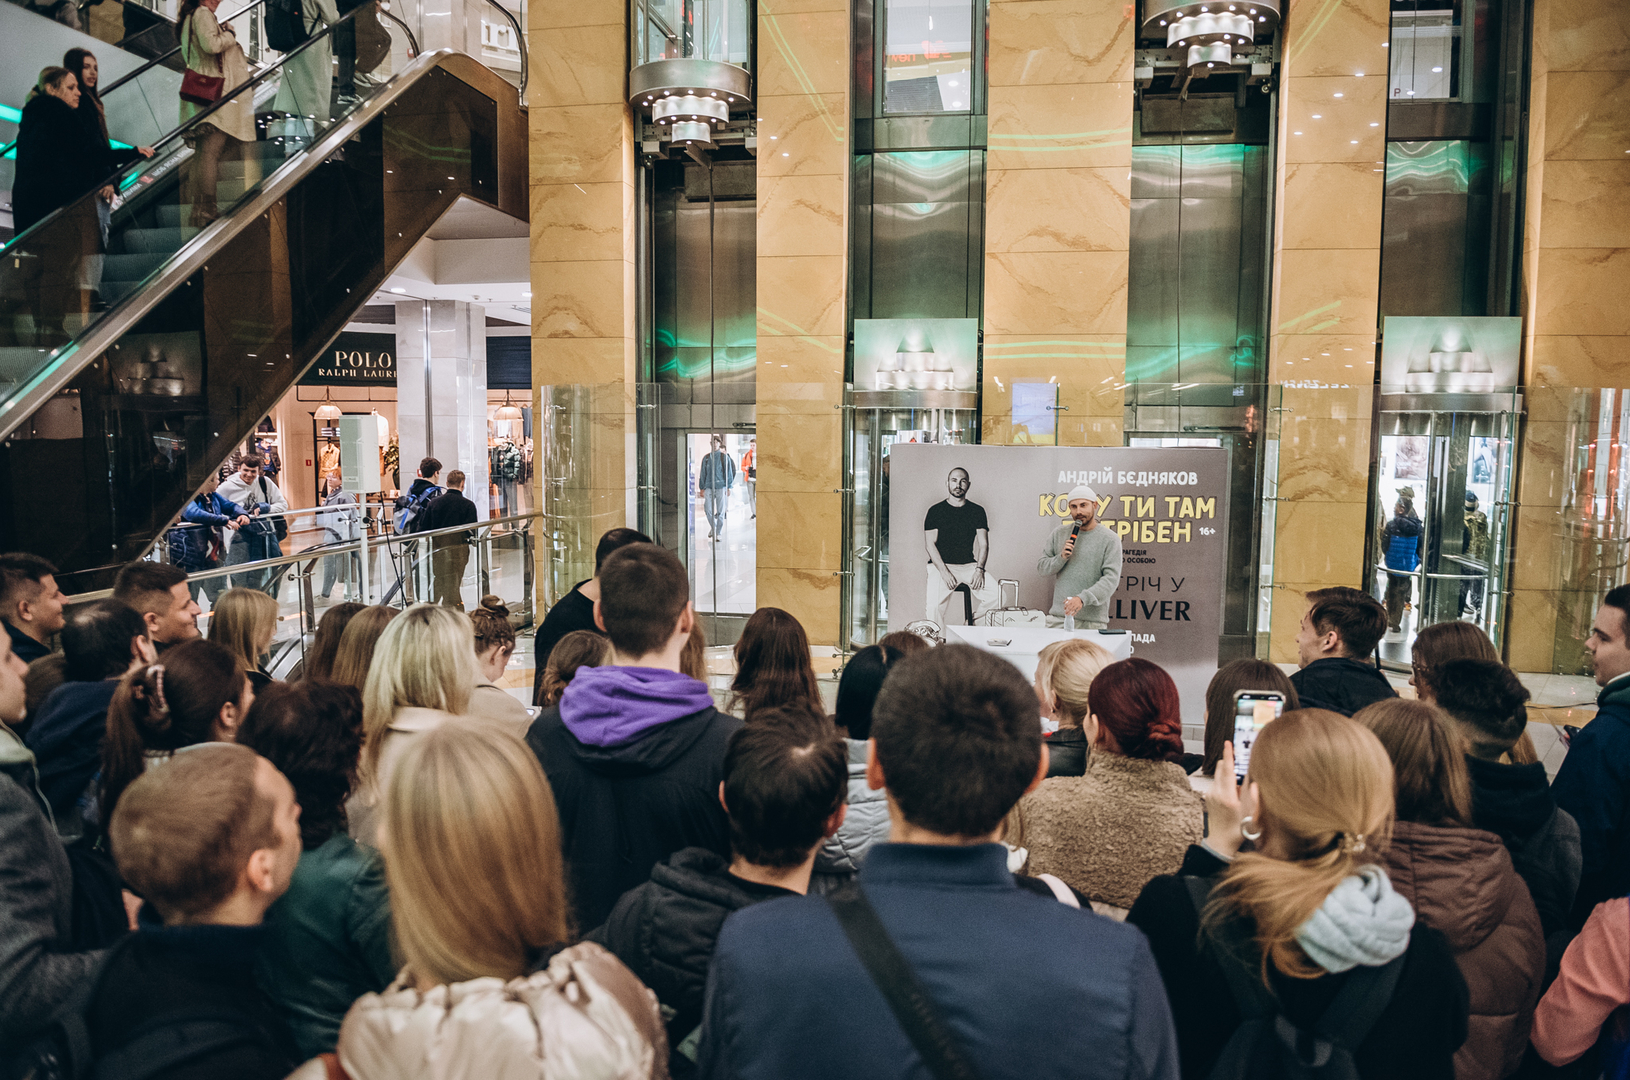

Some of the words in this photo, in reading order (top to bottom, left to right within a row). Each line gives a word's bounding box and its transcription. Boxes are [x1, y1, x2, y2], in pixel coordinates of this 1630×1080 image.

[335, 351, 392, 368] POLO
[318, 368, 357, 377] RALPH
[1058, 466, 1113, 486] АНДРІЙ
[1117, 471, 1198, 487] БЄДНЯКОВ
[1038, 493, 1113, 518] КОУ
[1119, 495, 1155, 519] ТИ
[1164, 495, 1217, 520] ТАМ
[1199, 526, 1216, 536] 16+
[1108, 599, 1191, 621] LIVER
